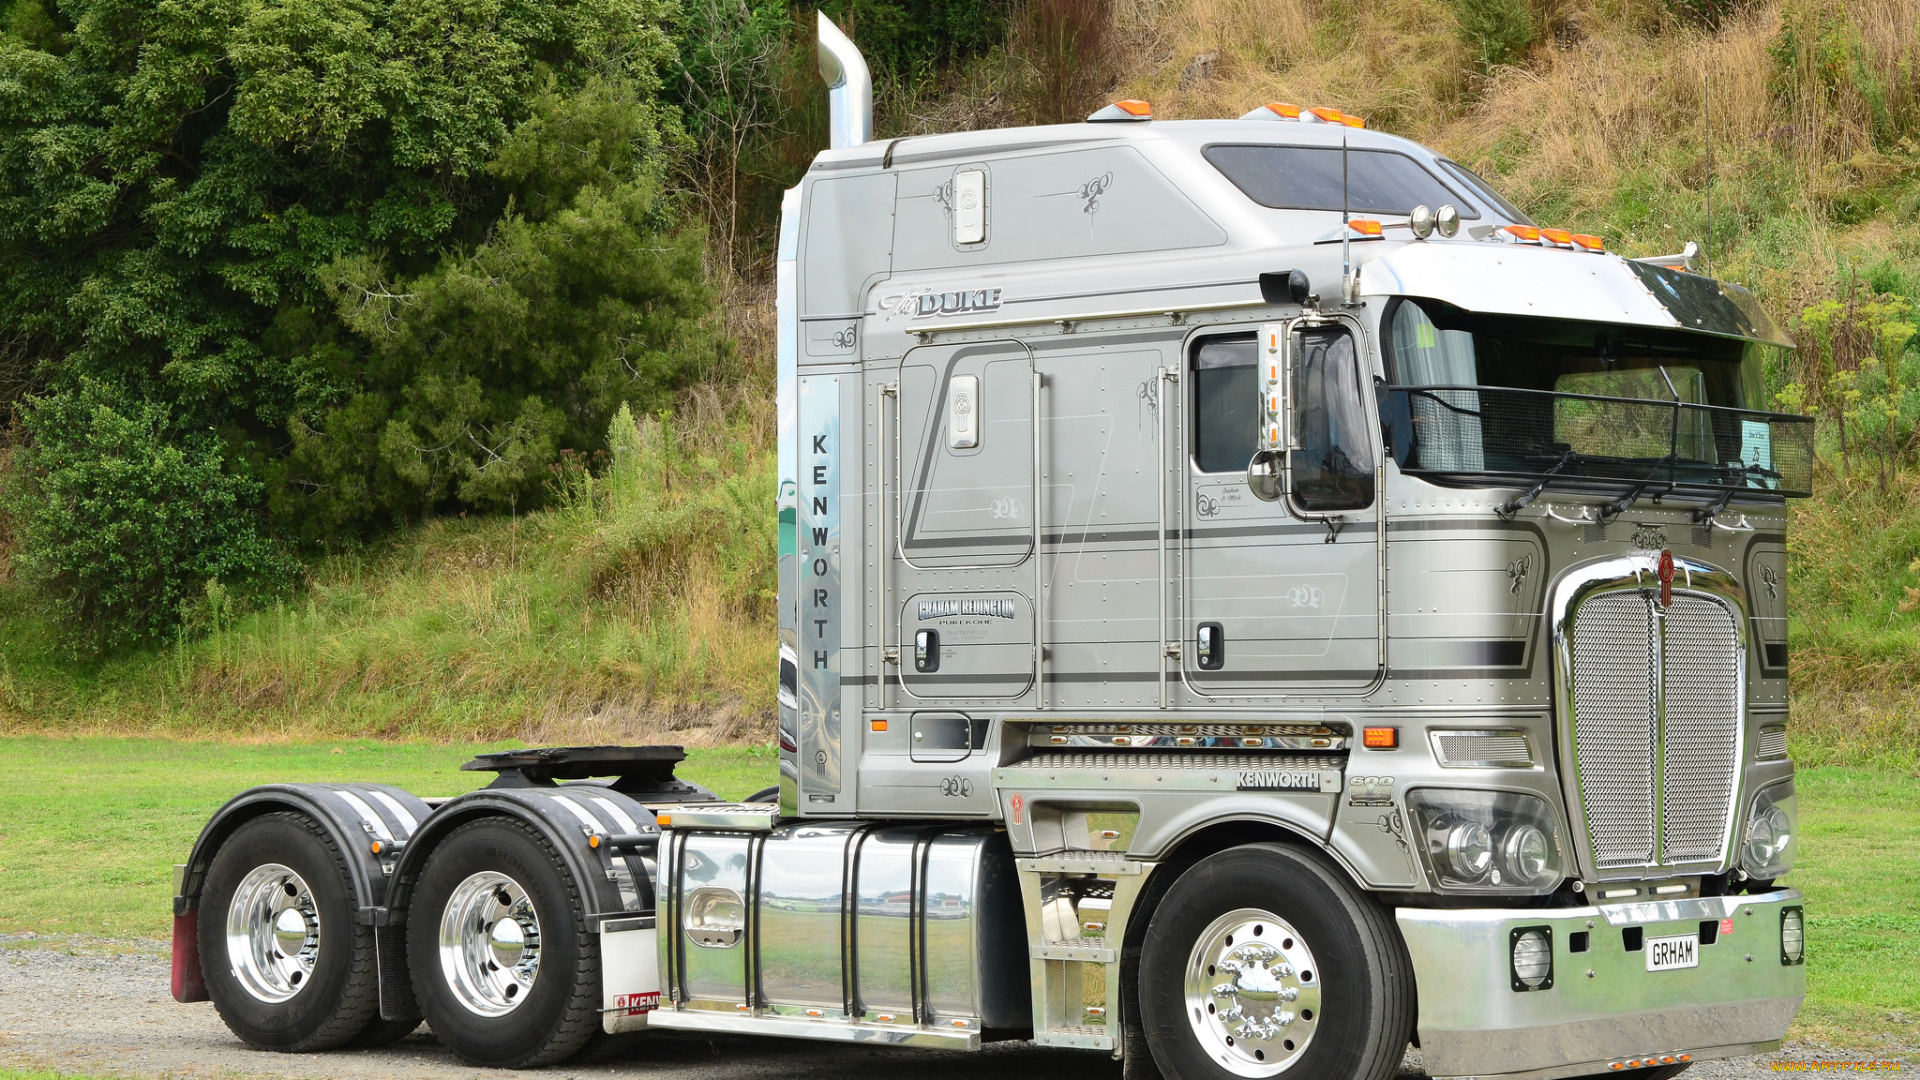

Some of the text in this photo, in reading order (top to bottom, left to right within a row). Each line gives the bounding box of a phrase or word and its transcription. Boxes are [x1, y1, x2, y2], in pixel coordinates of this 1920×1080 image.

[915, 287, 1003, 319] DUKE
[812, 434, 829, 669] KENWORTH
[918, 599, 1015, 621] GRAHAM REDINGTON
[1237, 772, 1320, 788] KENWORTH
[1350, 775, 1395, 786] 600
[1652, 940, 1693, 965] GRHAM
